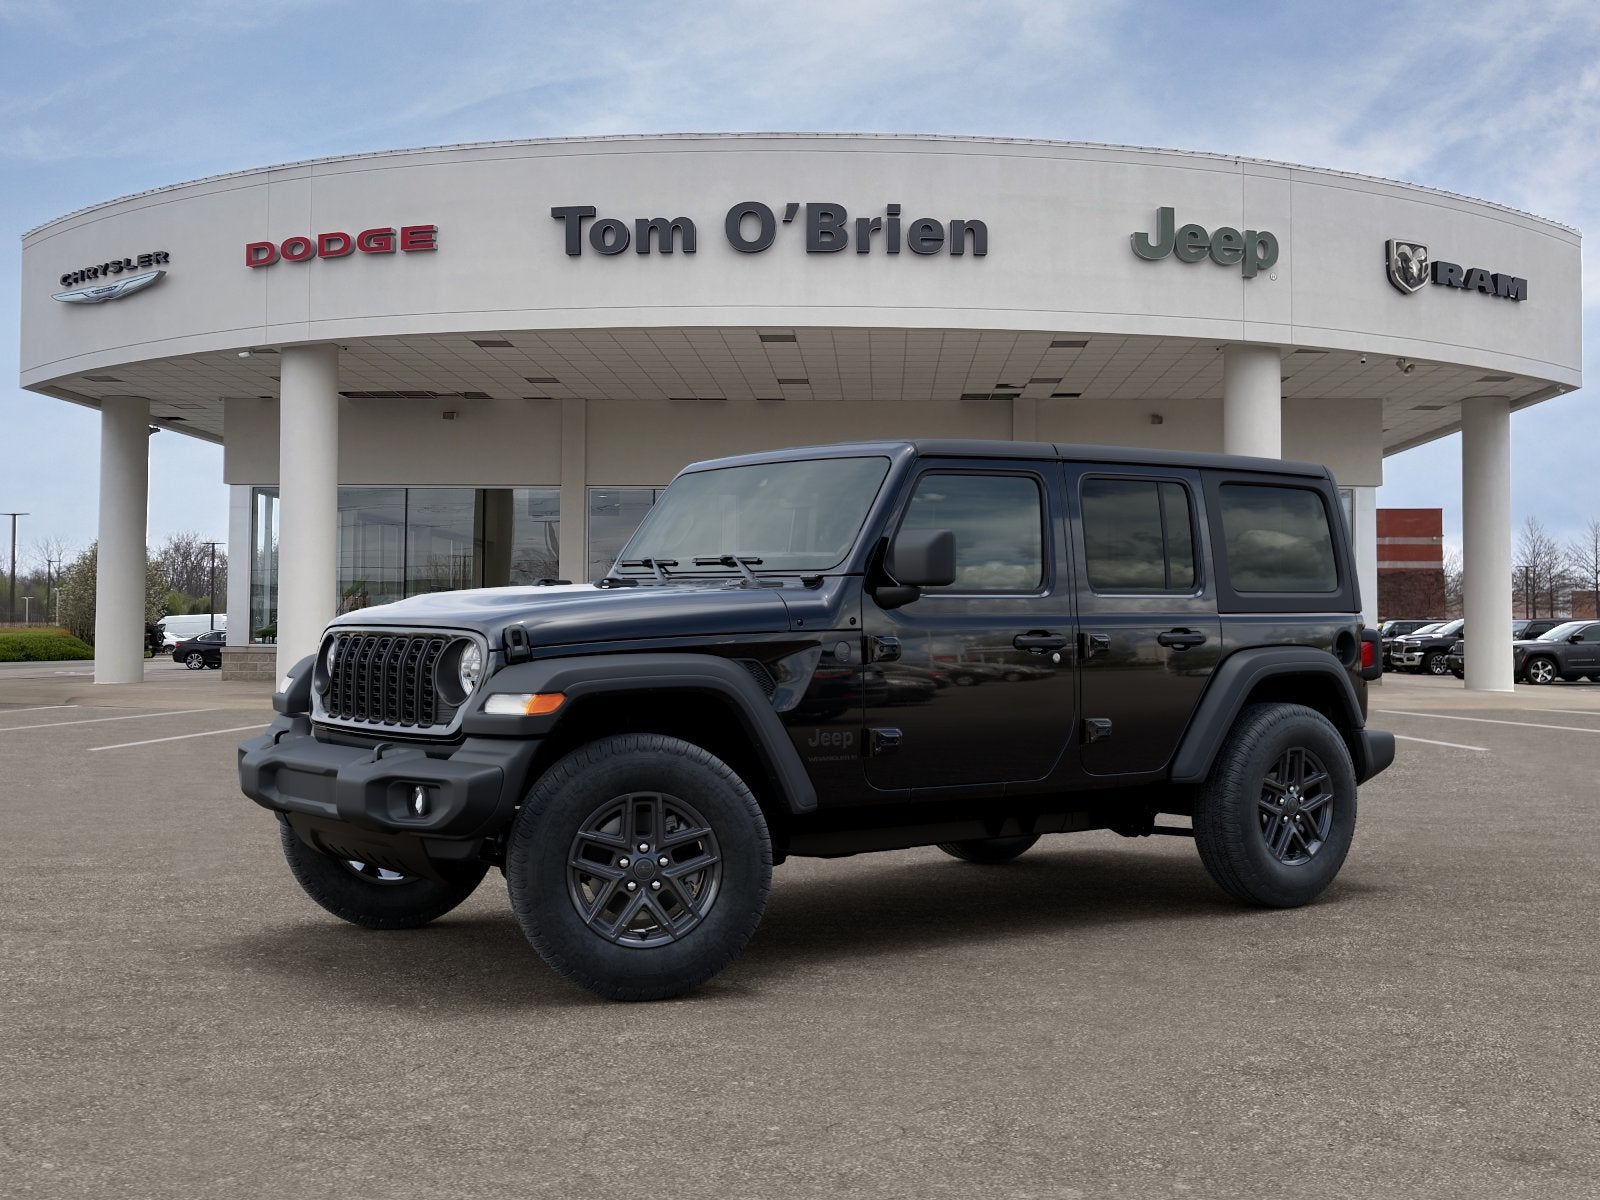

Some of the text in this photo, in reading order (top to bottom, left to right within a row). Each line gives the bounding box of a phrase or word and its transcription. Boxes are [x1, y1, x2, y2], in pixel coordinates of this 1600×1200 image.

[245, 224, 439, 268] DODGE
[550, 201, 989, 257] Tom O'Brien
[1130, 206, 1280, 279] Jeep
[59, 250, 171, 287] CHRYSLER
[1430, 260, 1528, 302] RAM
[807, 728, 854, 749] Jeep
